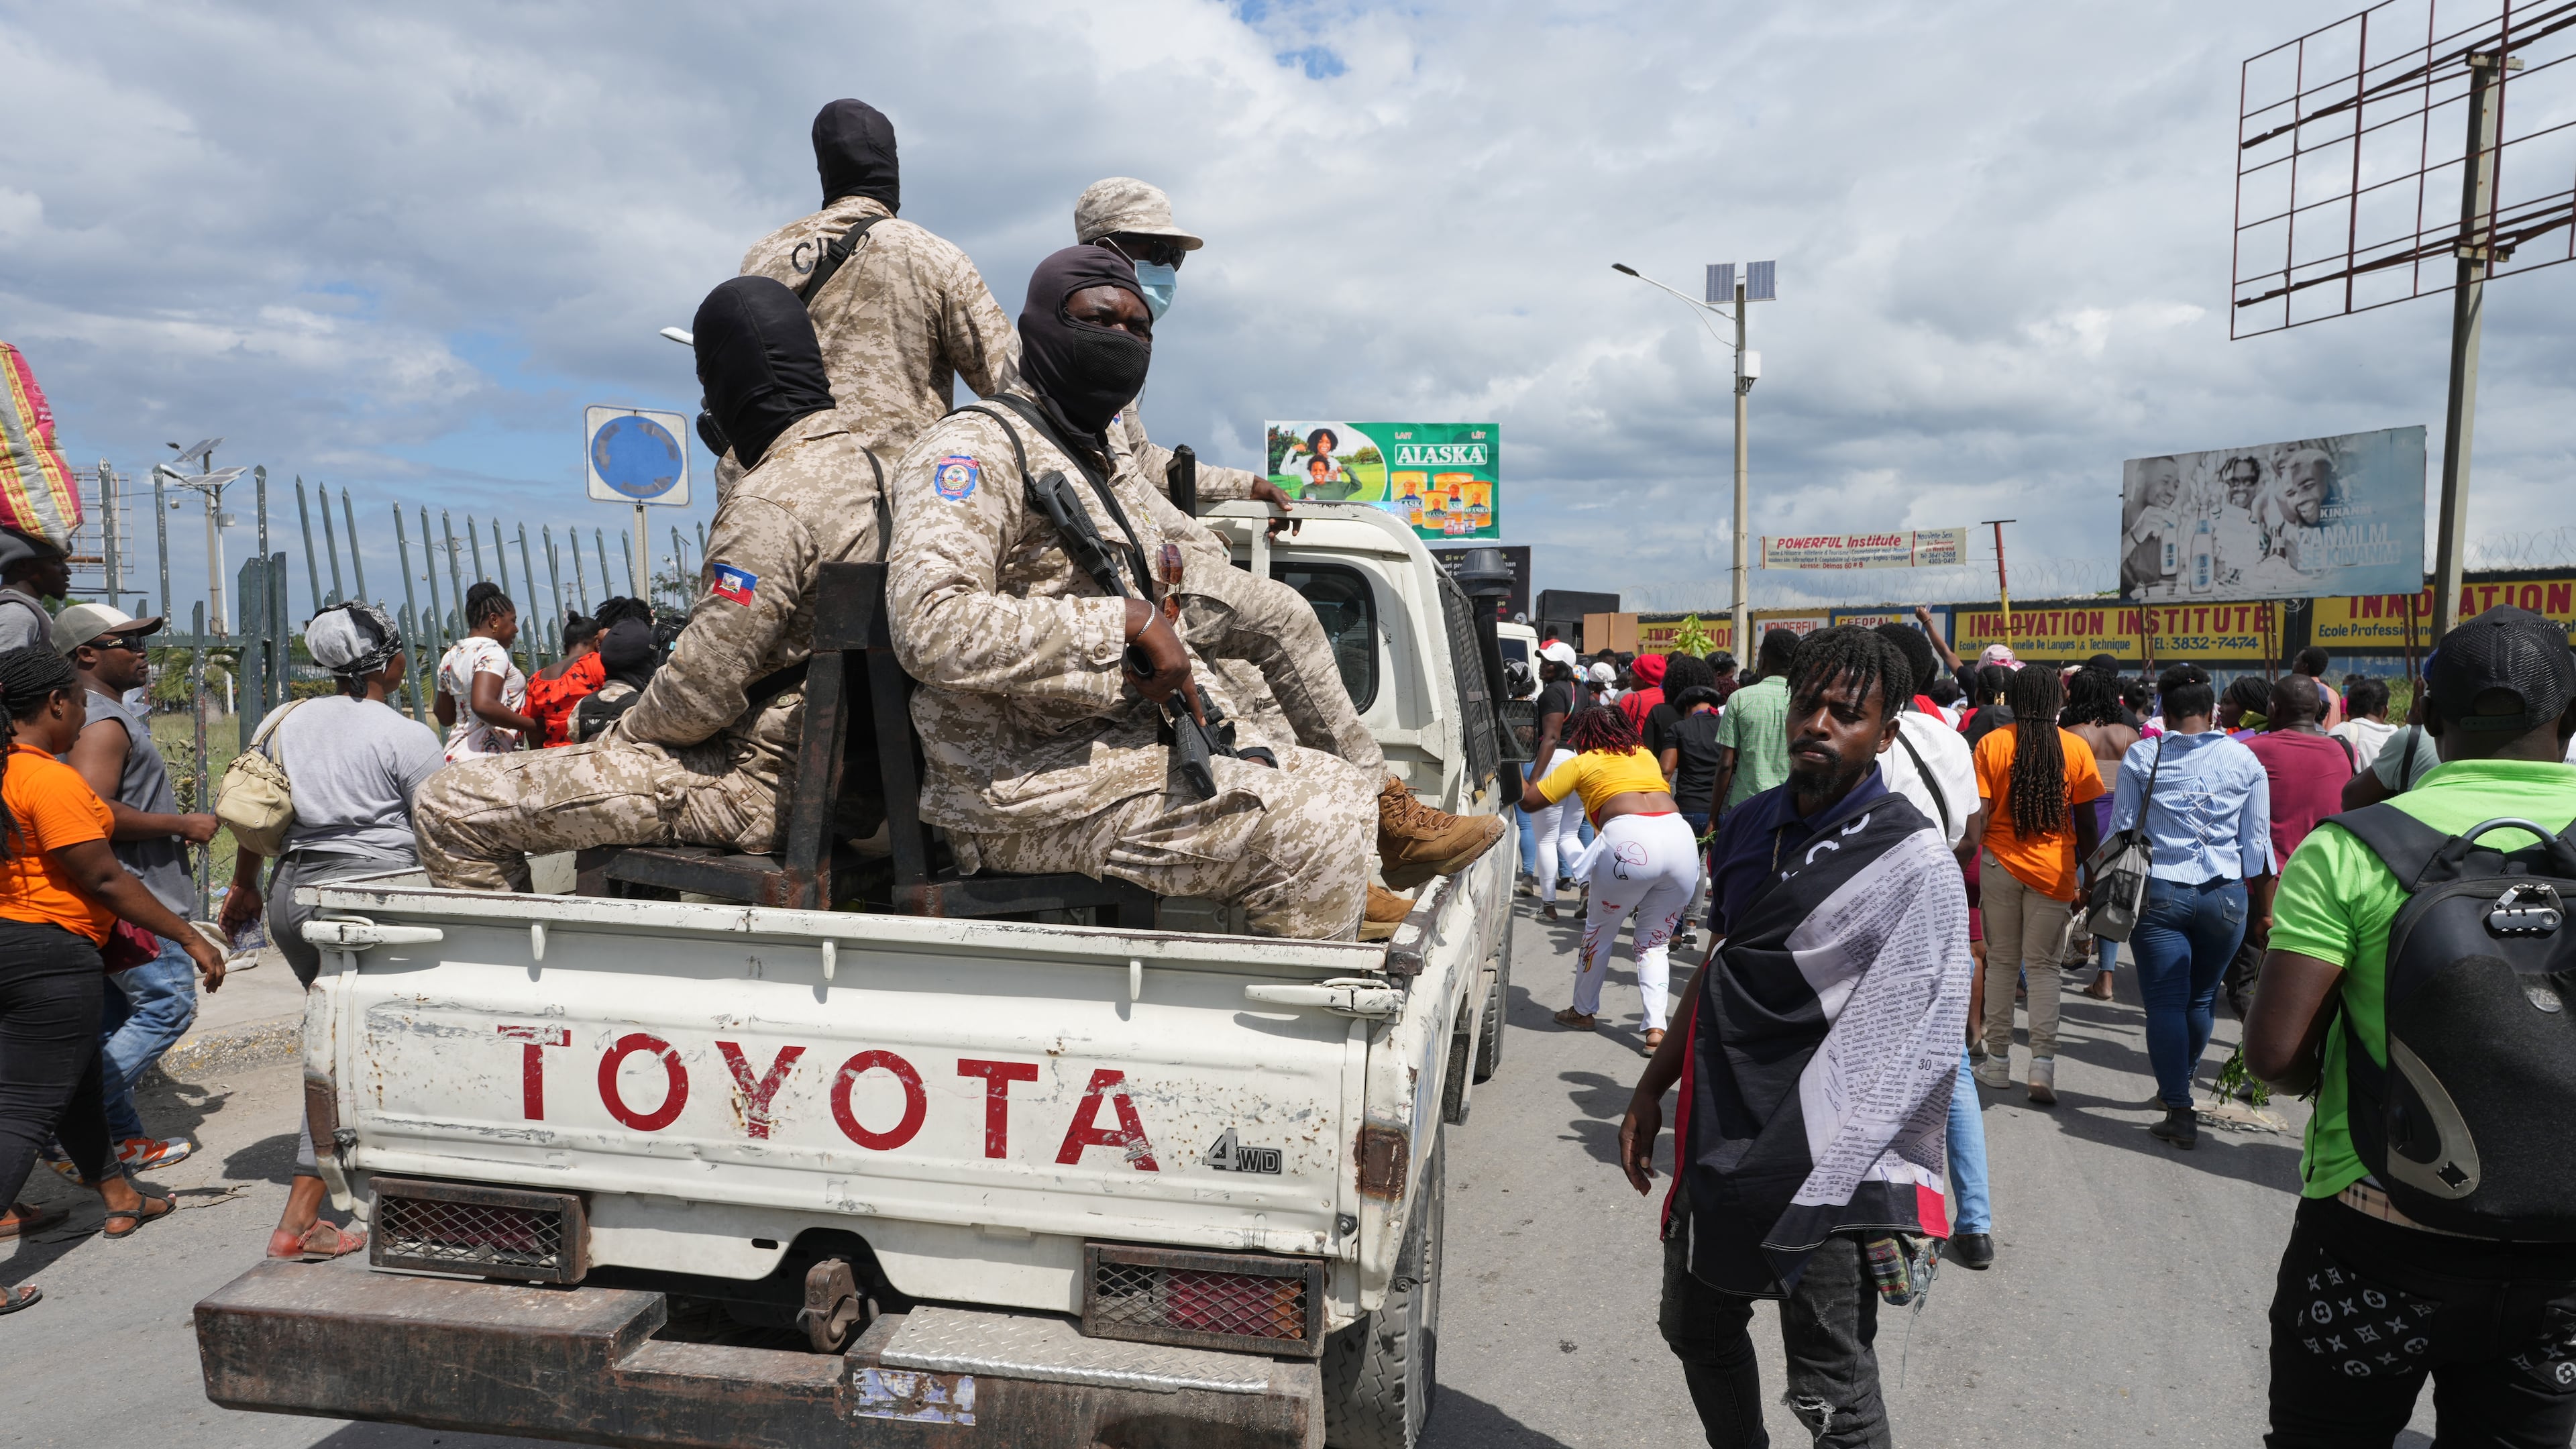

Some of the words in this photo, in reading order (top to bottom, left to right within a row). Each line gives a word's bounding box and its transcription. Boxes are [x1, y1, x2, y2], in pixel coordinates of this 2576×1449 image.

[1397, 446, 1485, 464] ALASKA
[2320, 506, 2372, 518] KINANM
[1777, 537, 1843, 550] POWERFUL
[1847, 534, 1901, 548] Institute
[2349, 582, 2572, 619] INNOATION
[1969, 611, 2104, 637] INNOVATION
[2117, 606, 2272, 635] INSTITUTE
[2318, 624, 2348, 637] Ecole
[1959, 641, 1976, 650] Ecole
[2047, 638, 2076, 653] Langues
[2080, 641, 2086, 650] &
[2090, 638, 2131, 653] Technique
[2171, 636, 2259, 650] 3832-7474
[1918, 1059, 1932, 1071] 30
[496, 1025, 1159, 1171] TOYOTA
[1202, 1127, 1281, 1174] 4WD
